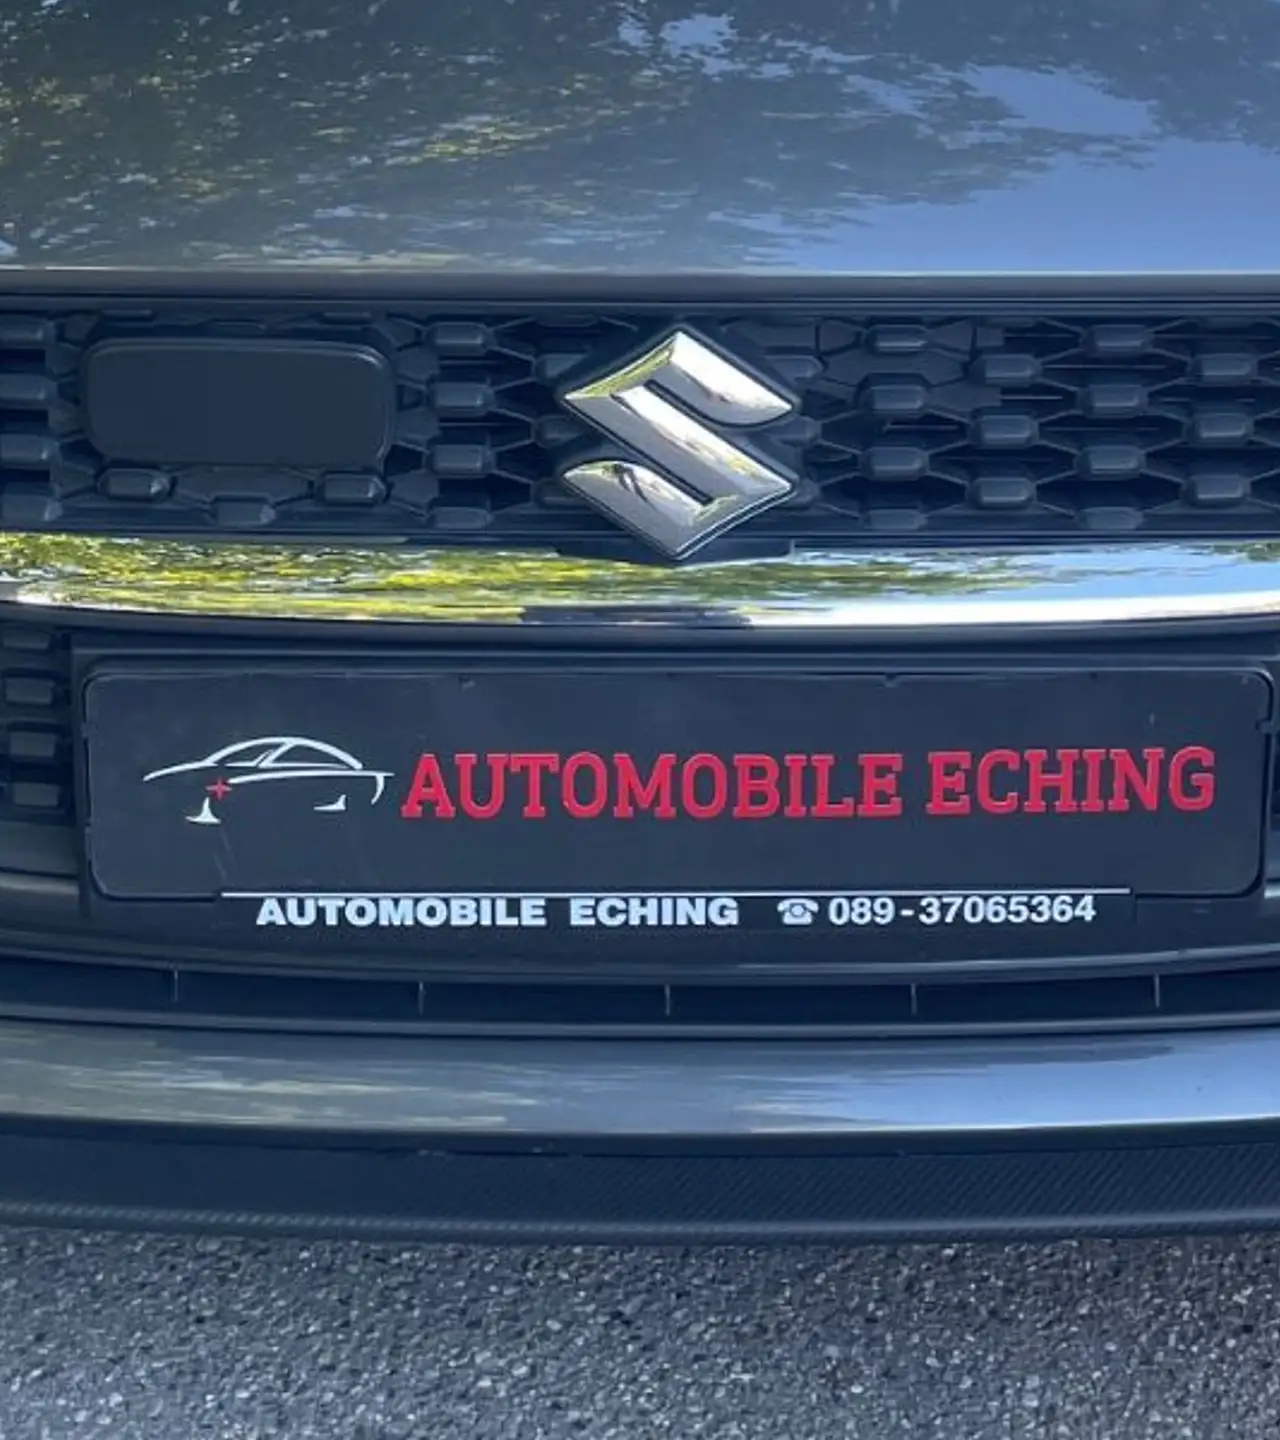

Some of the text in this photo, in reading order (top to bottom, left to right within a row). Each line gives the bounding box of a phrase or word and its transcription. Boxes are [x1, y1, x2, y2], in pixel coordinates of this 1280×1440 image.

[402, 746, 1215, 819] AUTOMOBILE ECHING
[255, 895, 1097, 927] AUTOMOBILE ECHING 089-37065364
